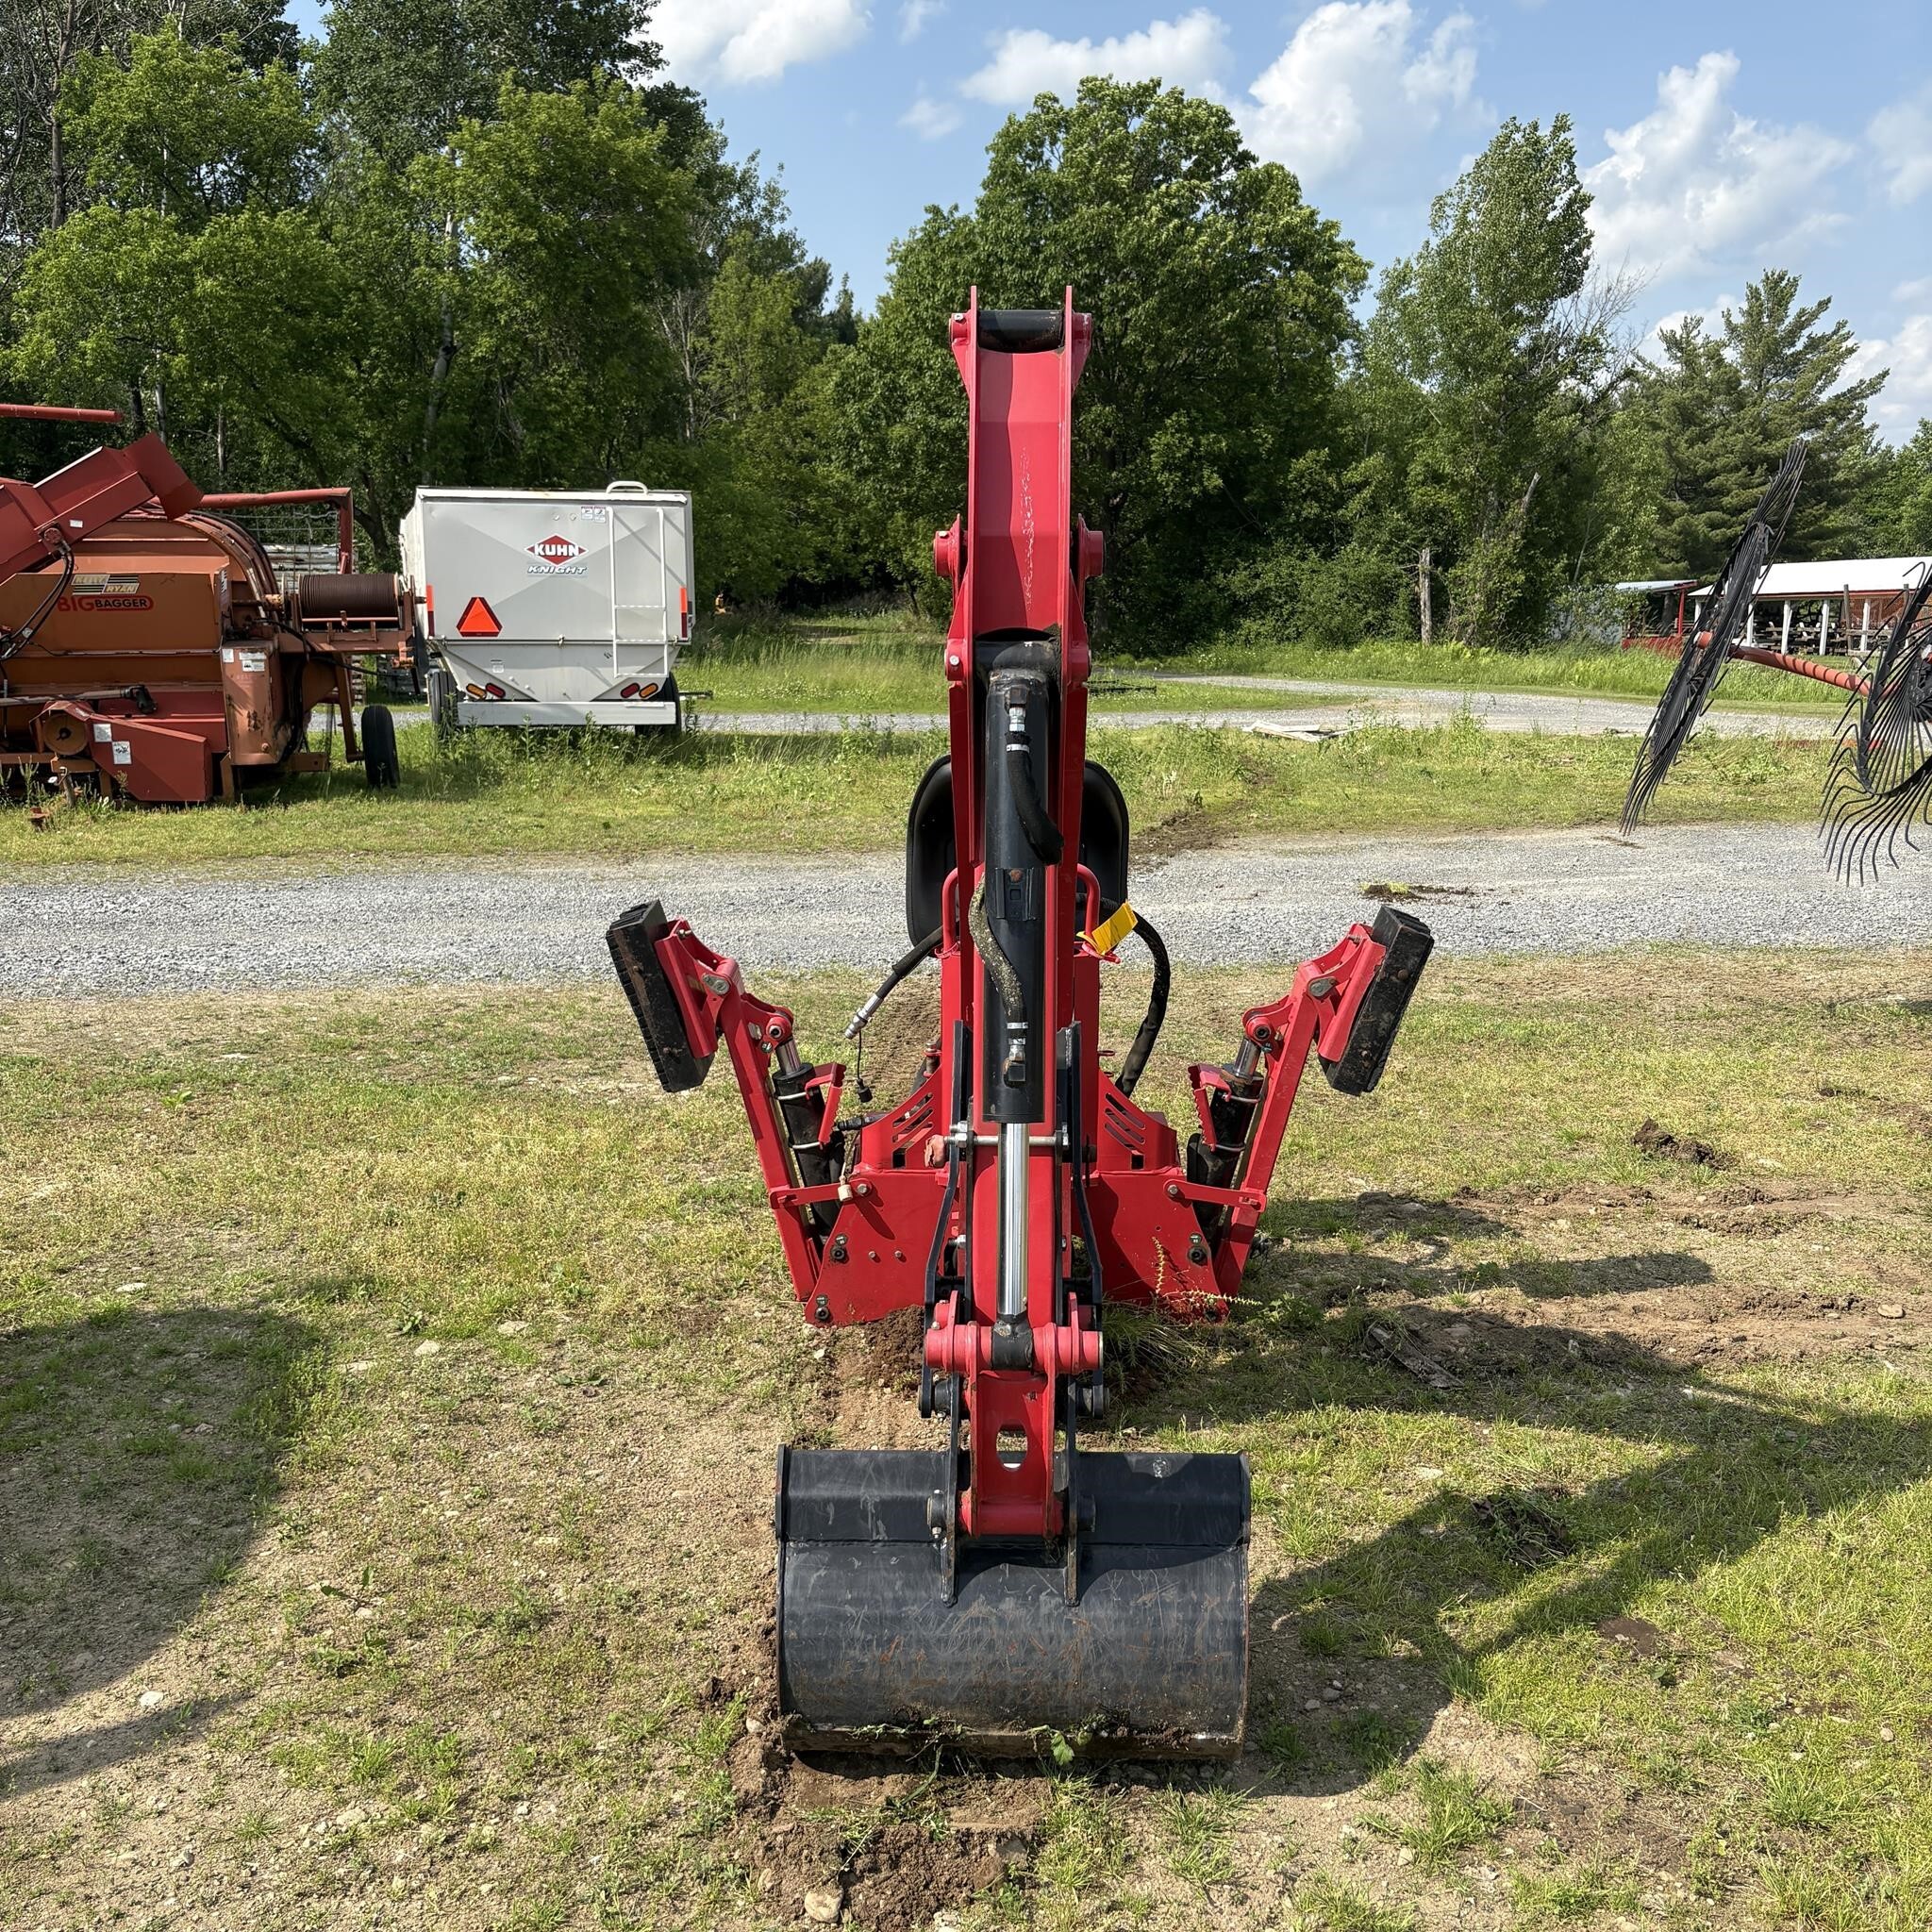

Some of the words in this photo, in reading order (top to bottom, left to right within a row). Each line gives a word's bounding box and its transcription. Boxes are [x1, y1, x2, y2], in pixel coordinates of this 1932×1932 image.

[535, 543, 578, 557] KUHN
[527, 566, 587, 575] KNIGHT
[58, 596, 94, 611] BIG
[94, 598, 147, 608] BAGGER
